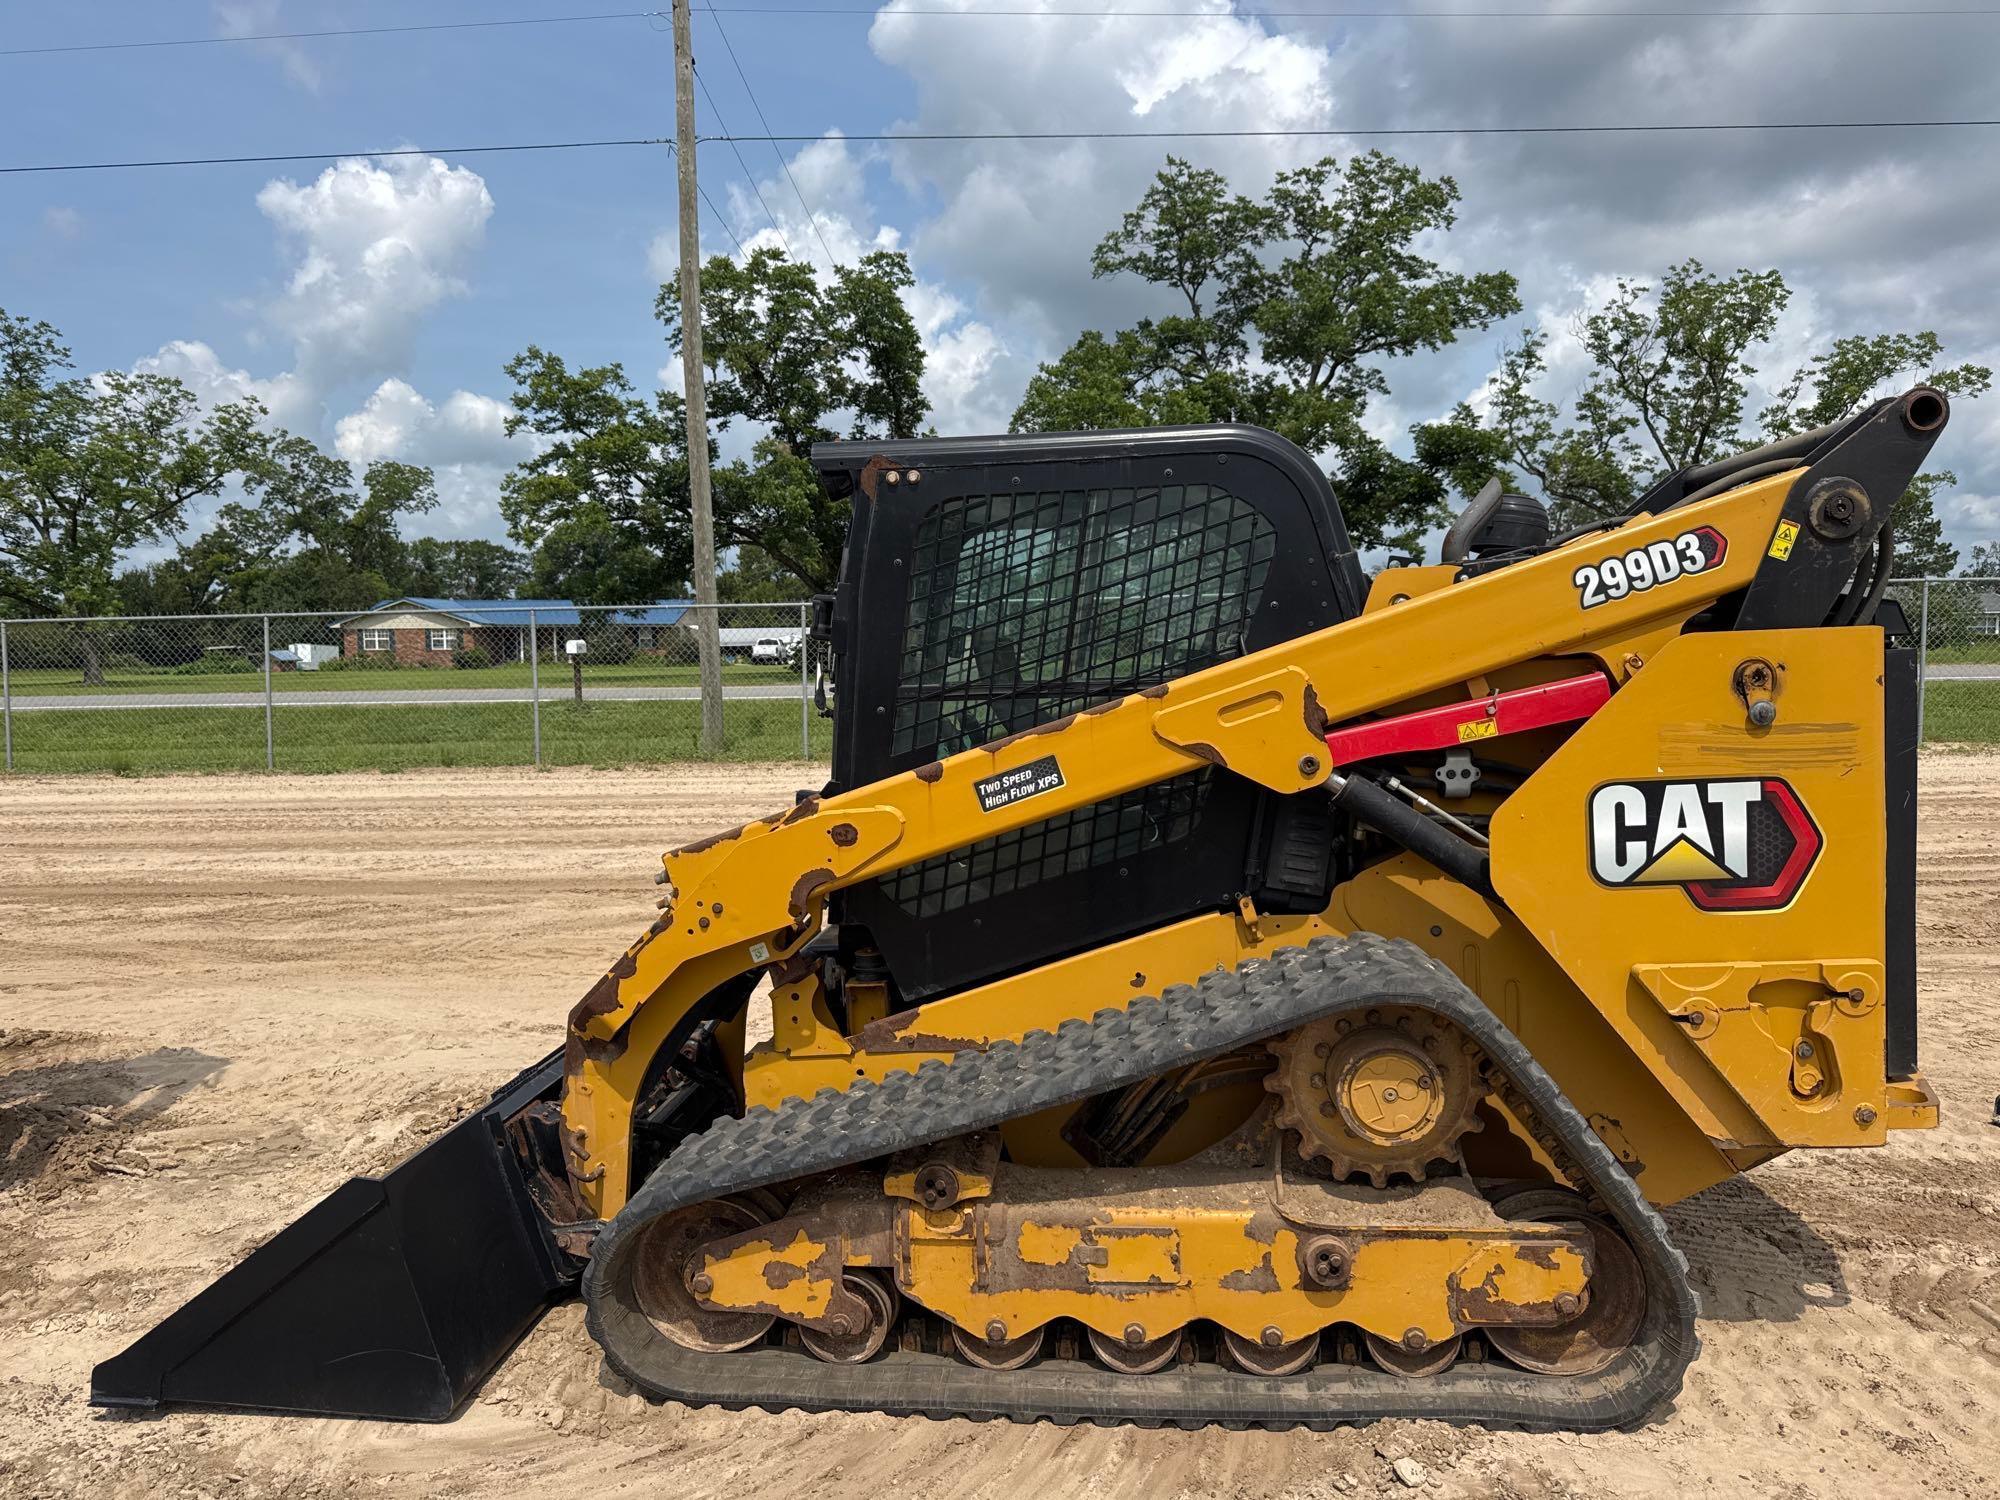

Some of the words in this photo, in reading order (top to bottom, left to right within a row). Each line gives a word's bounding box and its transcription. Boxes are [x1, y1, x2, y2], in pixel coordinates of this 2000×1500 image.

[1575, 533, 1706, 608] 299D3
[979, 781, 1001, 796] TWO
[1002, 769, 1032, 787] SPEED
[985, 792, 1009, 808] HIGH
[1010, 782, 1035, 799] FLOW
[1037, 773, 1059, 790] XPS
[1592, 781, 1762, 883] CAT
